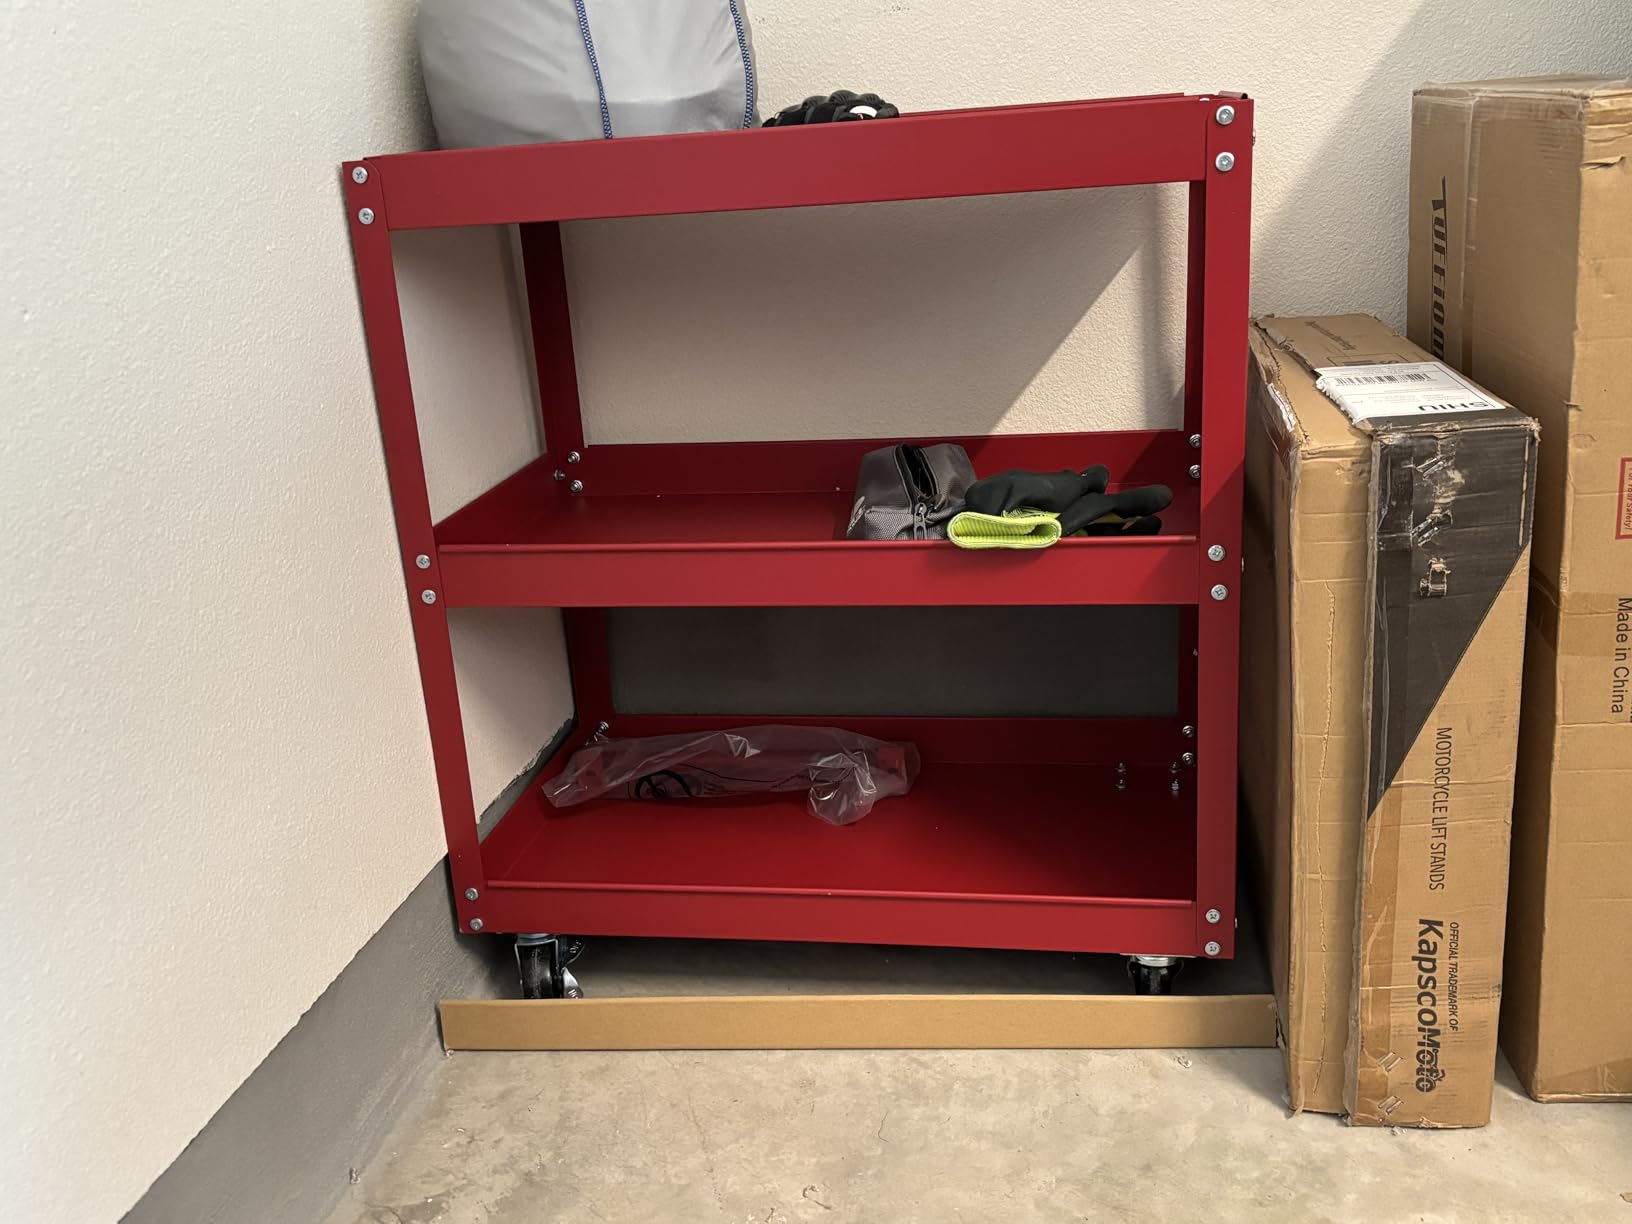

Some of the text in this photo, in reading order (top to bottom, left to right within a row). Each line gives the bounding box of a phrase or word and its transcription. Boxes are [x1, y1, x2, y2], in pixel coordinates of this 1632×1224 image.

[1611, 598, 1632, 713] Made in China
[1429, 727, 1452, 891] MOTORCYCLE LIFT STANDS
[1411, 918, 1444, 1092] KapscoMoto
[1448, 921, 1459, 1031] OFFICIAL TRADEMARK OF
